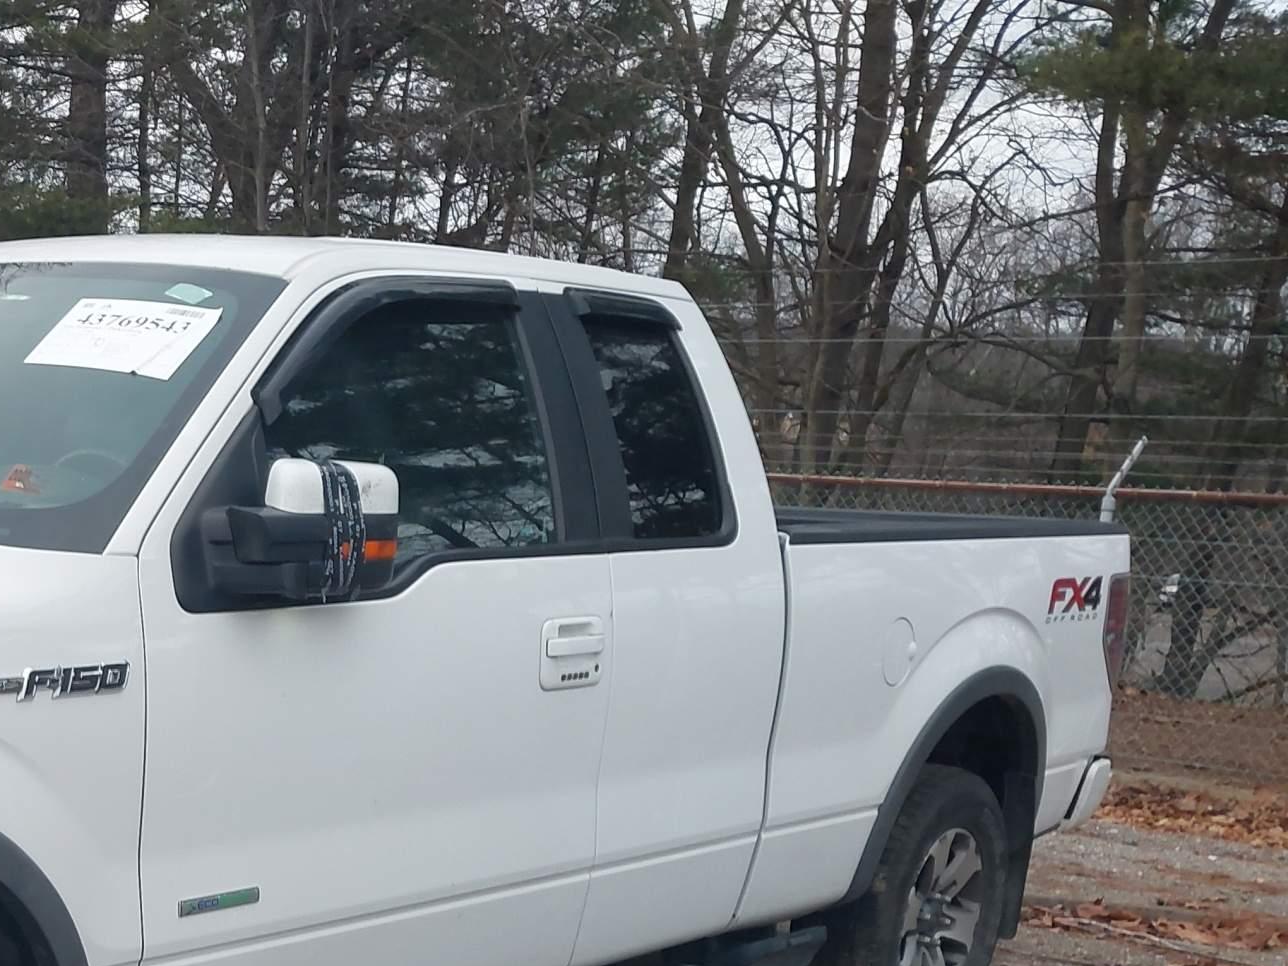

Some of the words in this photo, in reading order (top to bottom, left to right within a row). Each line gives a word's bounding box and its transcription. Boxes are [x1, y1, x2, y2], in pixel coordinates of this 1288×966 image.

[77, 313, 192, 334] 43769543
[1047, 575, 1104, 615] FX4
[1045, 615, 1066, 624] OFF
[1070, 613, 1098, 622] ROAD
